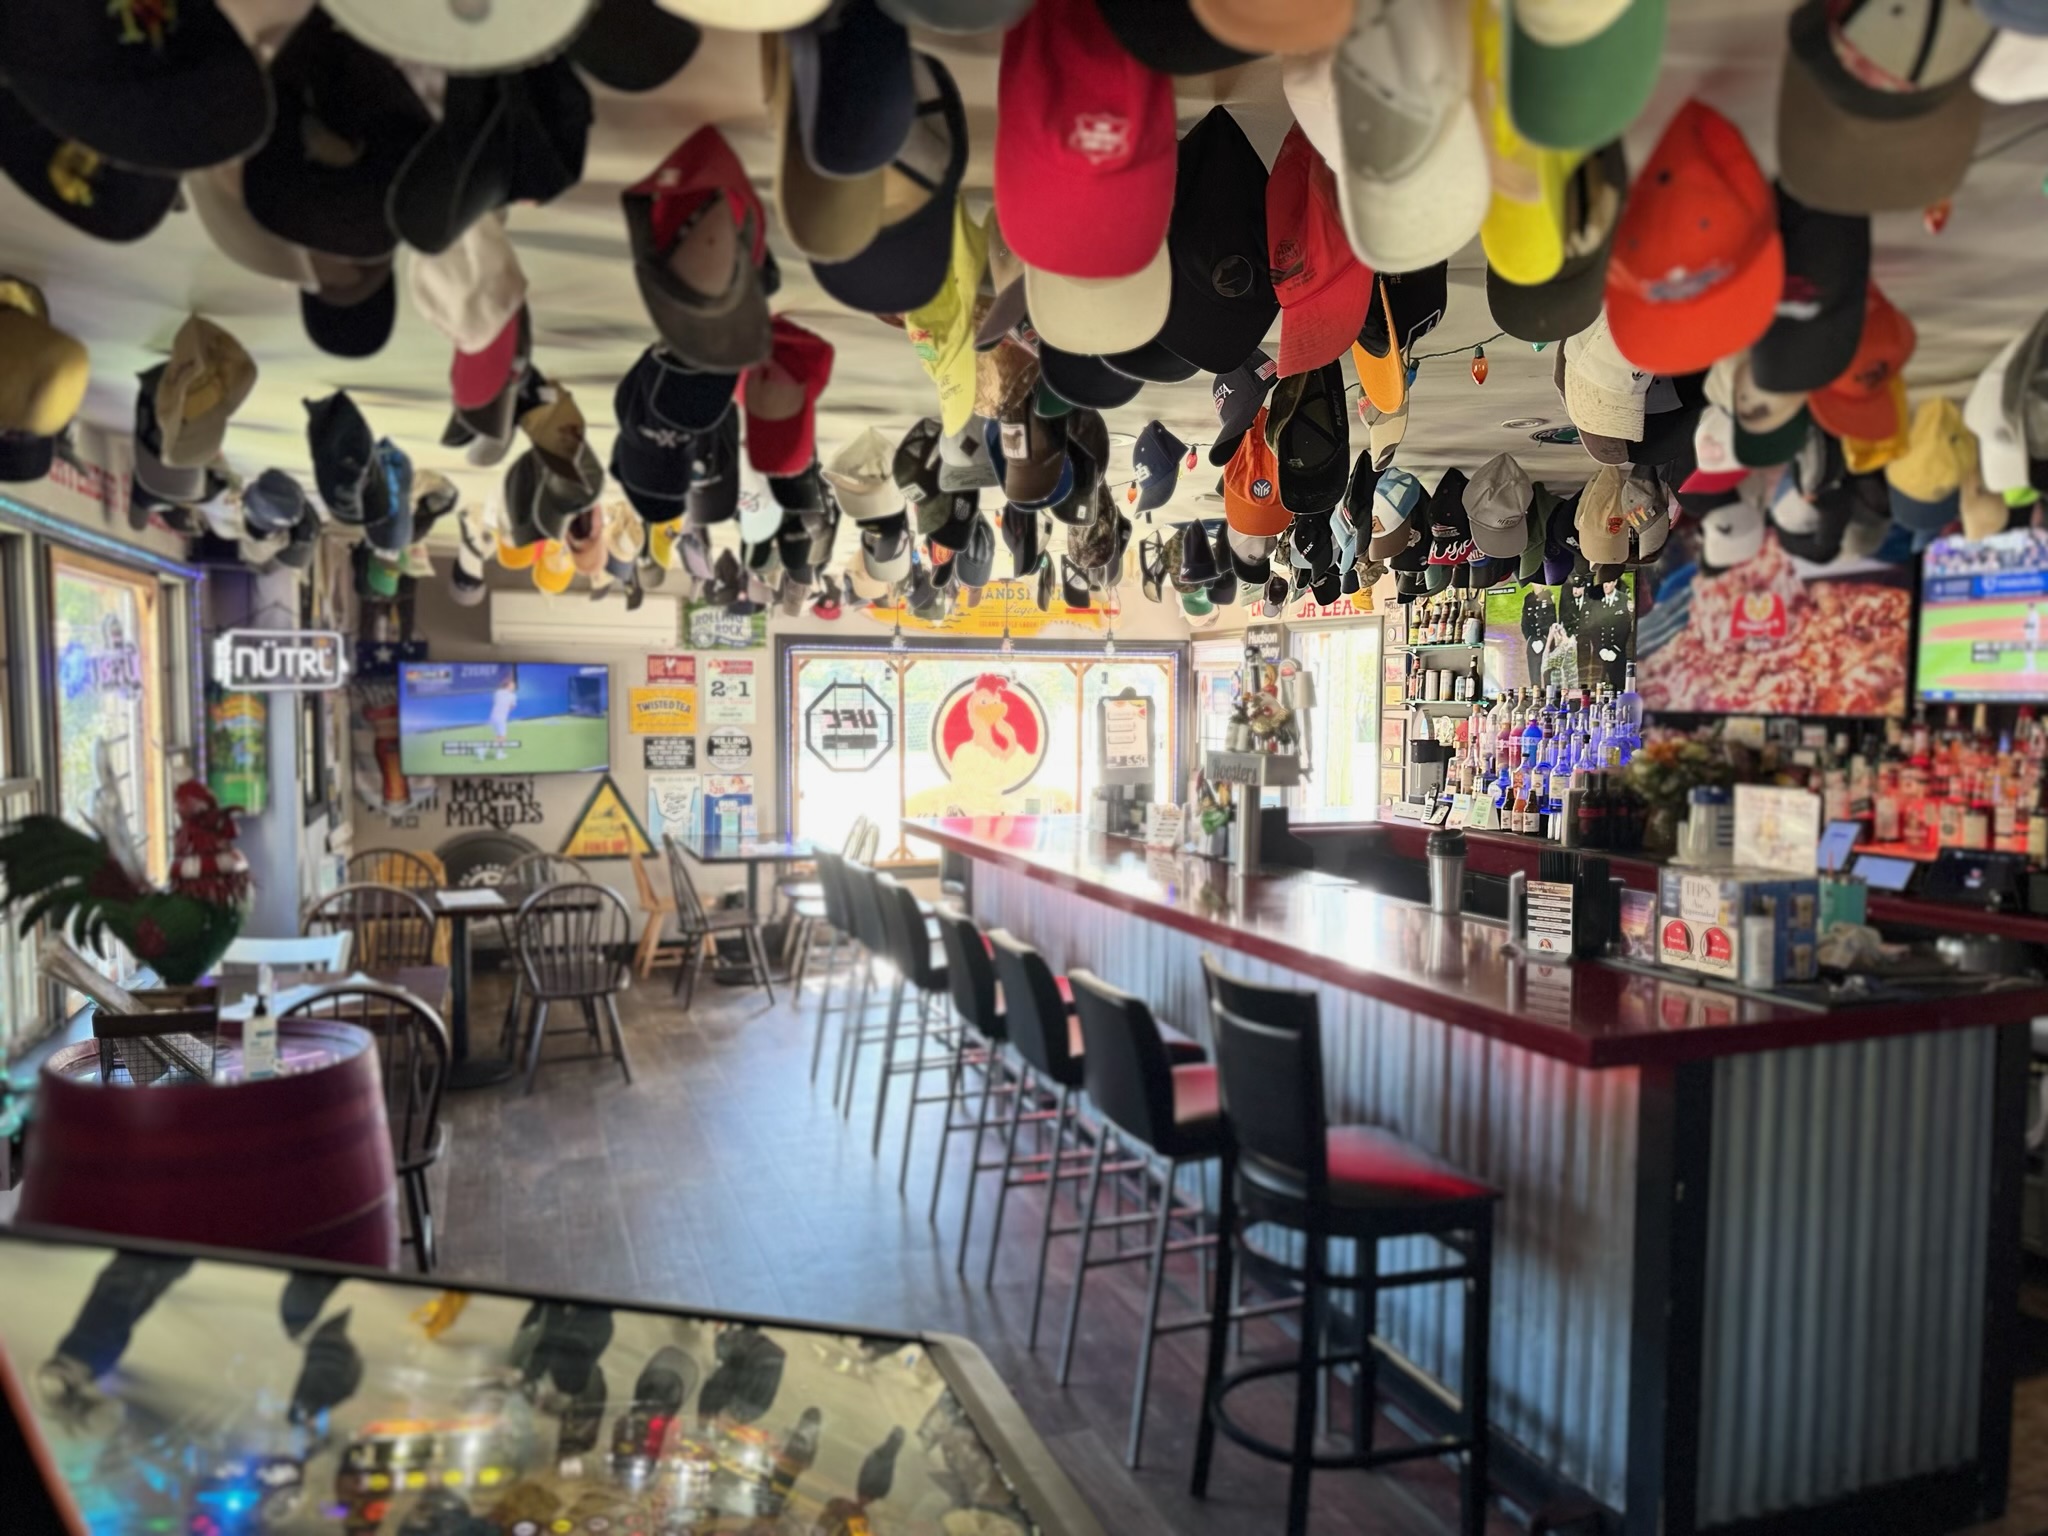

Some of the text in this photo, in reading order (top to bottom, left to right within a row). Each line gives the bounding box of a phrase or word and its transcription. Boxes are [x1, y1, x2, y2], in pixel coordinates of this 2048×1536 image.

[715, 622, 743, 636] ROCK
[1248, 631, 1278, 643] Hudson
[710, 681, 726, 697] 2
[738, 681, 750, 697] 1
[636, 700, 691, 713] TWISTED TEA
[1211, 757, 1258, 784] Roosters
[1686, 881, 1711, 898] TIPS
